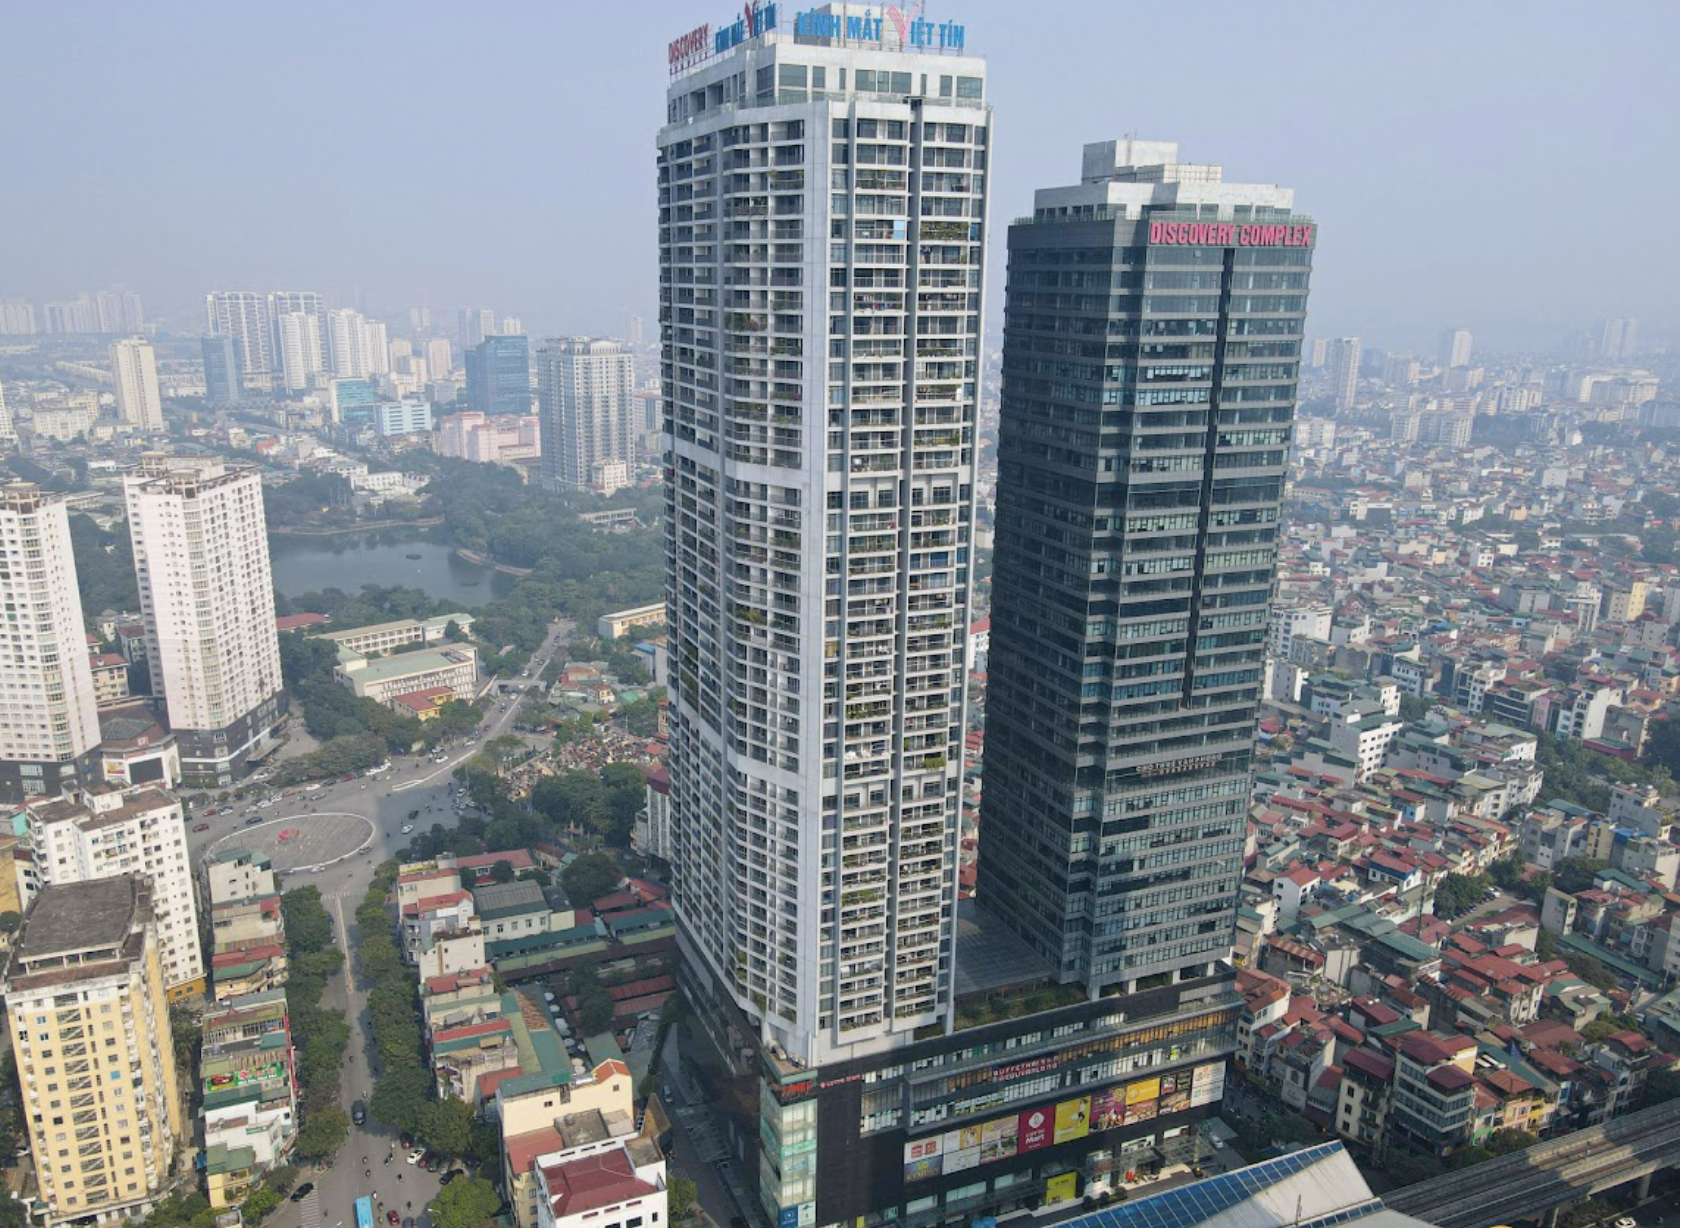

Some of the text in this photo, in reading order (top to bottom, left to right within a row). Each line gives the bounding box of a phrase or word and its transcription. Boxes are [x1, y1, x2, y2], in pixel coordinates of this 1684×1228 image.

[668, 23, 709, 65] DISCOVERY
[797, 7, 841, 39] KÍNH
[847, 9, 882, 41] MẮT
[939, 19, 965, 49] TÍN
[1151, 222, 1314, 247] DISCOVERY COMPLEX
